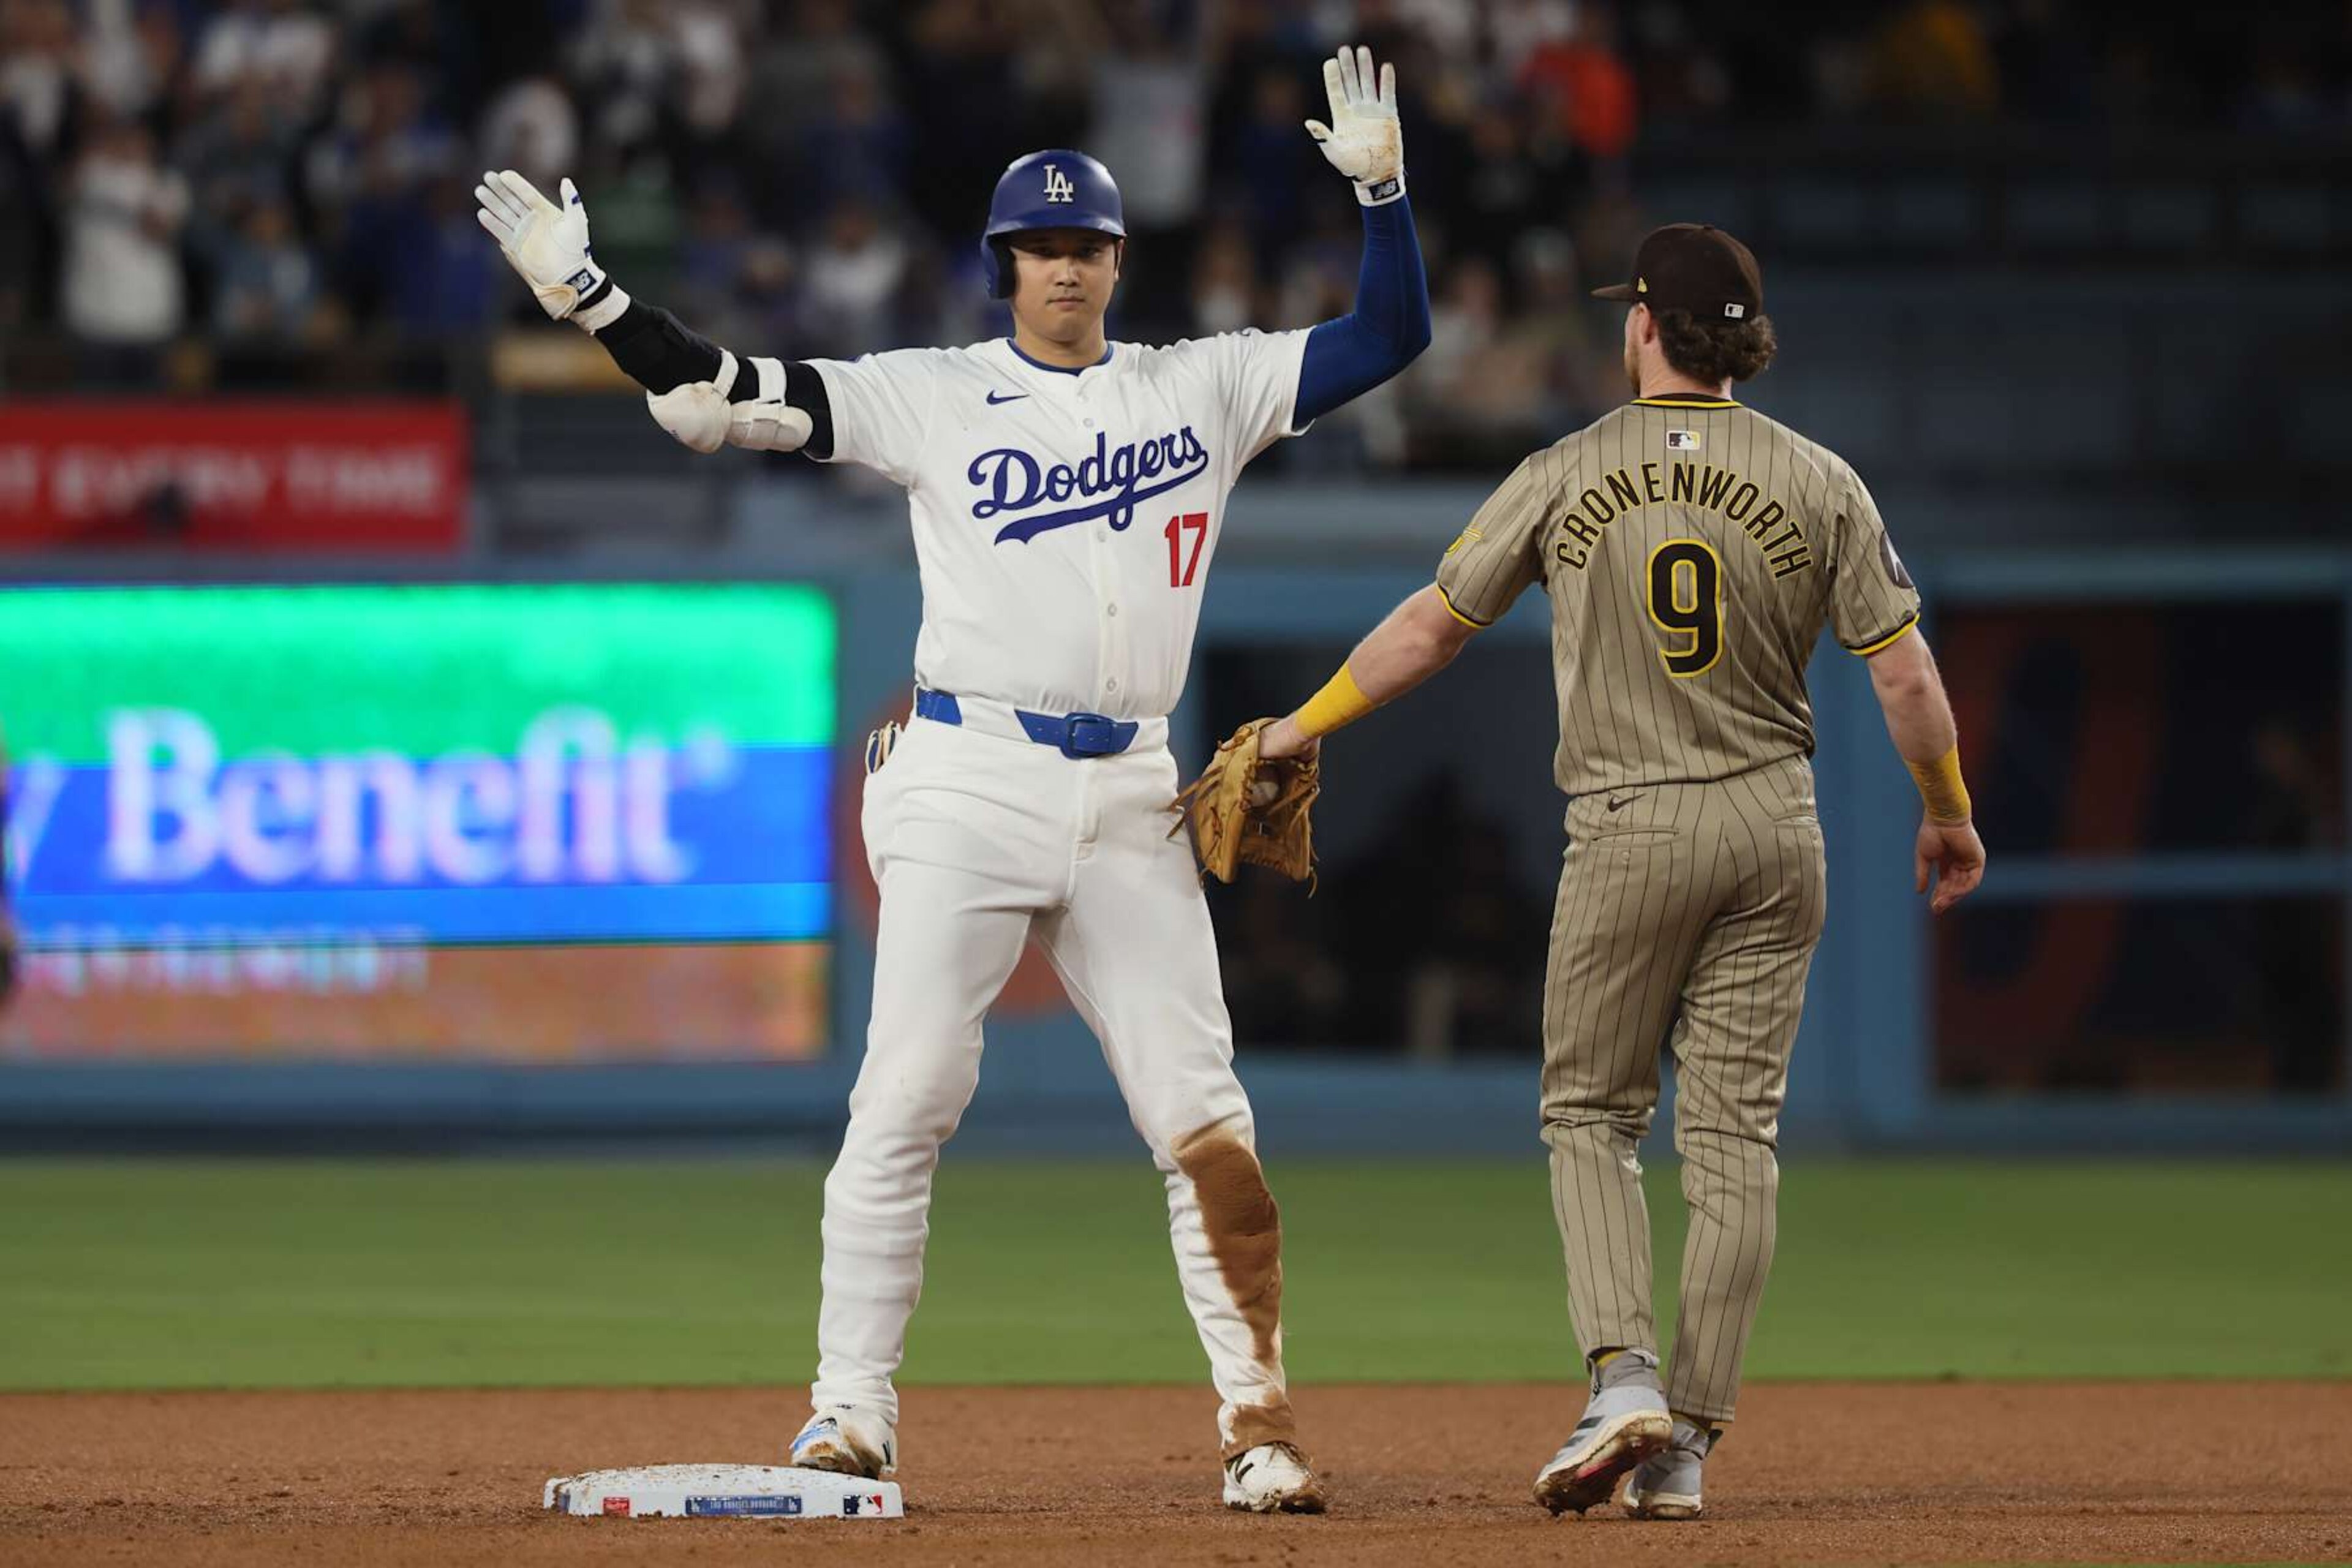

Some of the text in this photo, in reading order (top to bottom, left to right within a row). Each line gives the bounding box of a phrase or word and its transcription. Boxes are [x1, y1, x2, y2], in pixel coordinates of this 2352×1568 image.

[1043, 164, 1073, 202] LA
[968, 426, 1209, 534] Dodgers
[1556, 461, 1812, 579] CRONENWORTH
[1164, 512, 1208, 587] 17
[1647, 538, 1724, 679] 9
[103, 704, 695, 883] Benefit
